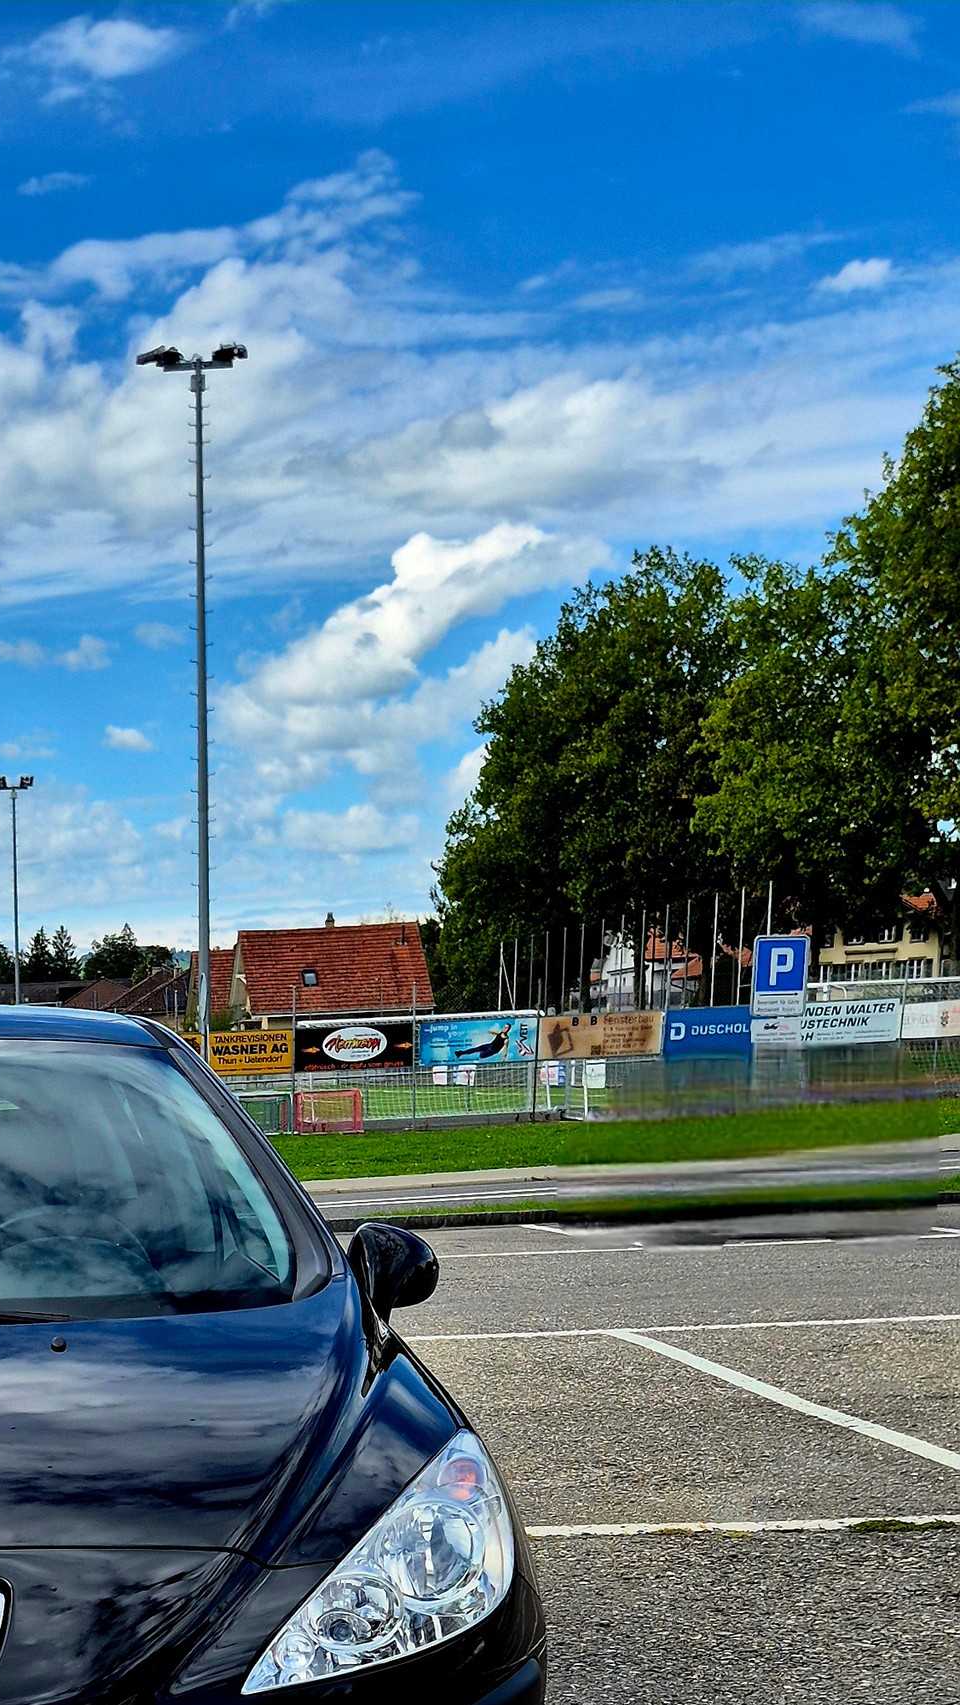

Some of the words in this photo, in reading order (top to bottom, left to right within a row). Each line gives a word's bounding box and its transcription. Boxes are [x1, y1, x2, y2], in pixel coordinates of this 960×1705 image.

[769, 947, 794, 986] P
[845, 1002, 896, 1015] WALTER
[691, 1023, 750, 1036] DUSCHOL
[213, 1033, 288, 1044] TANKREVISIONEN
[211, 1043, 268, 1057] WASNER
[270, 1042, 289, 1054] AG
[217, 1056, 238, 1065] Thun
